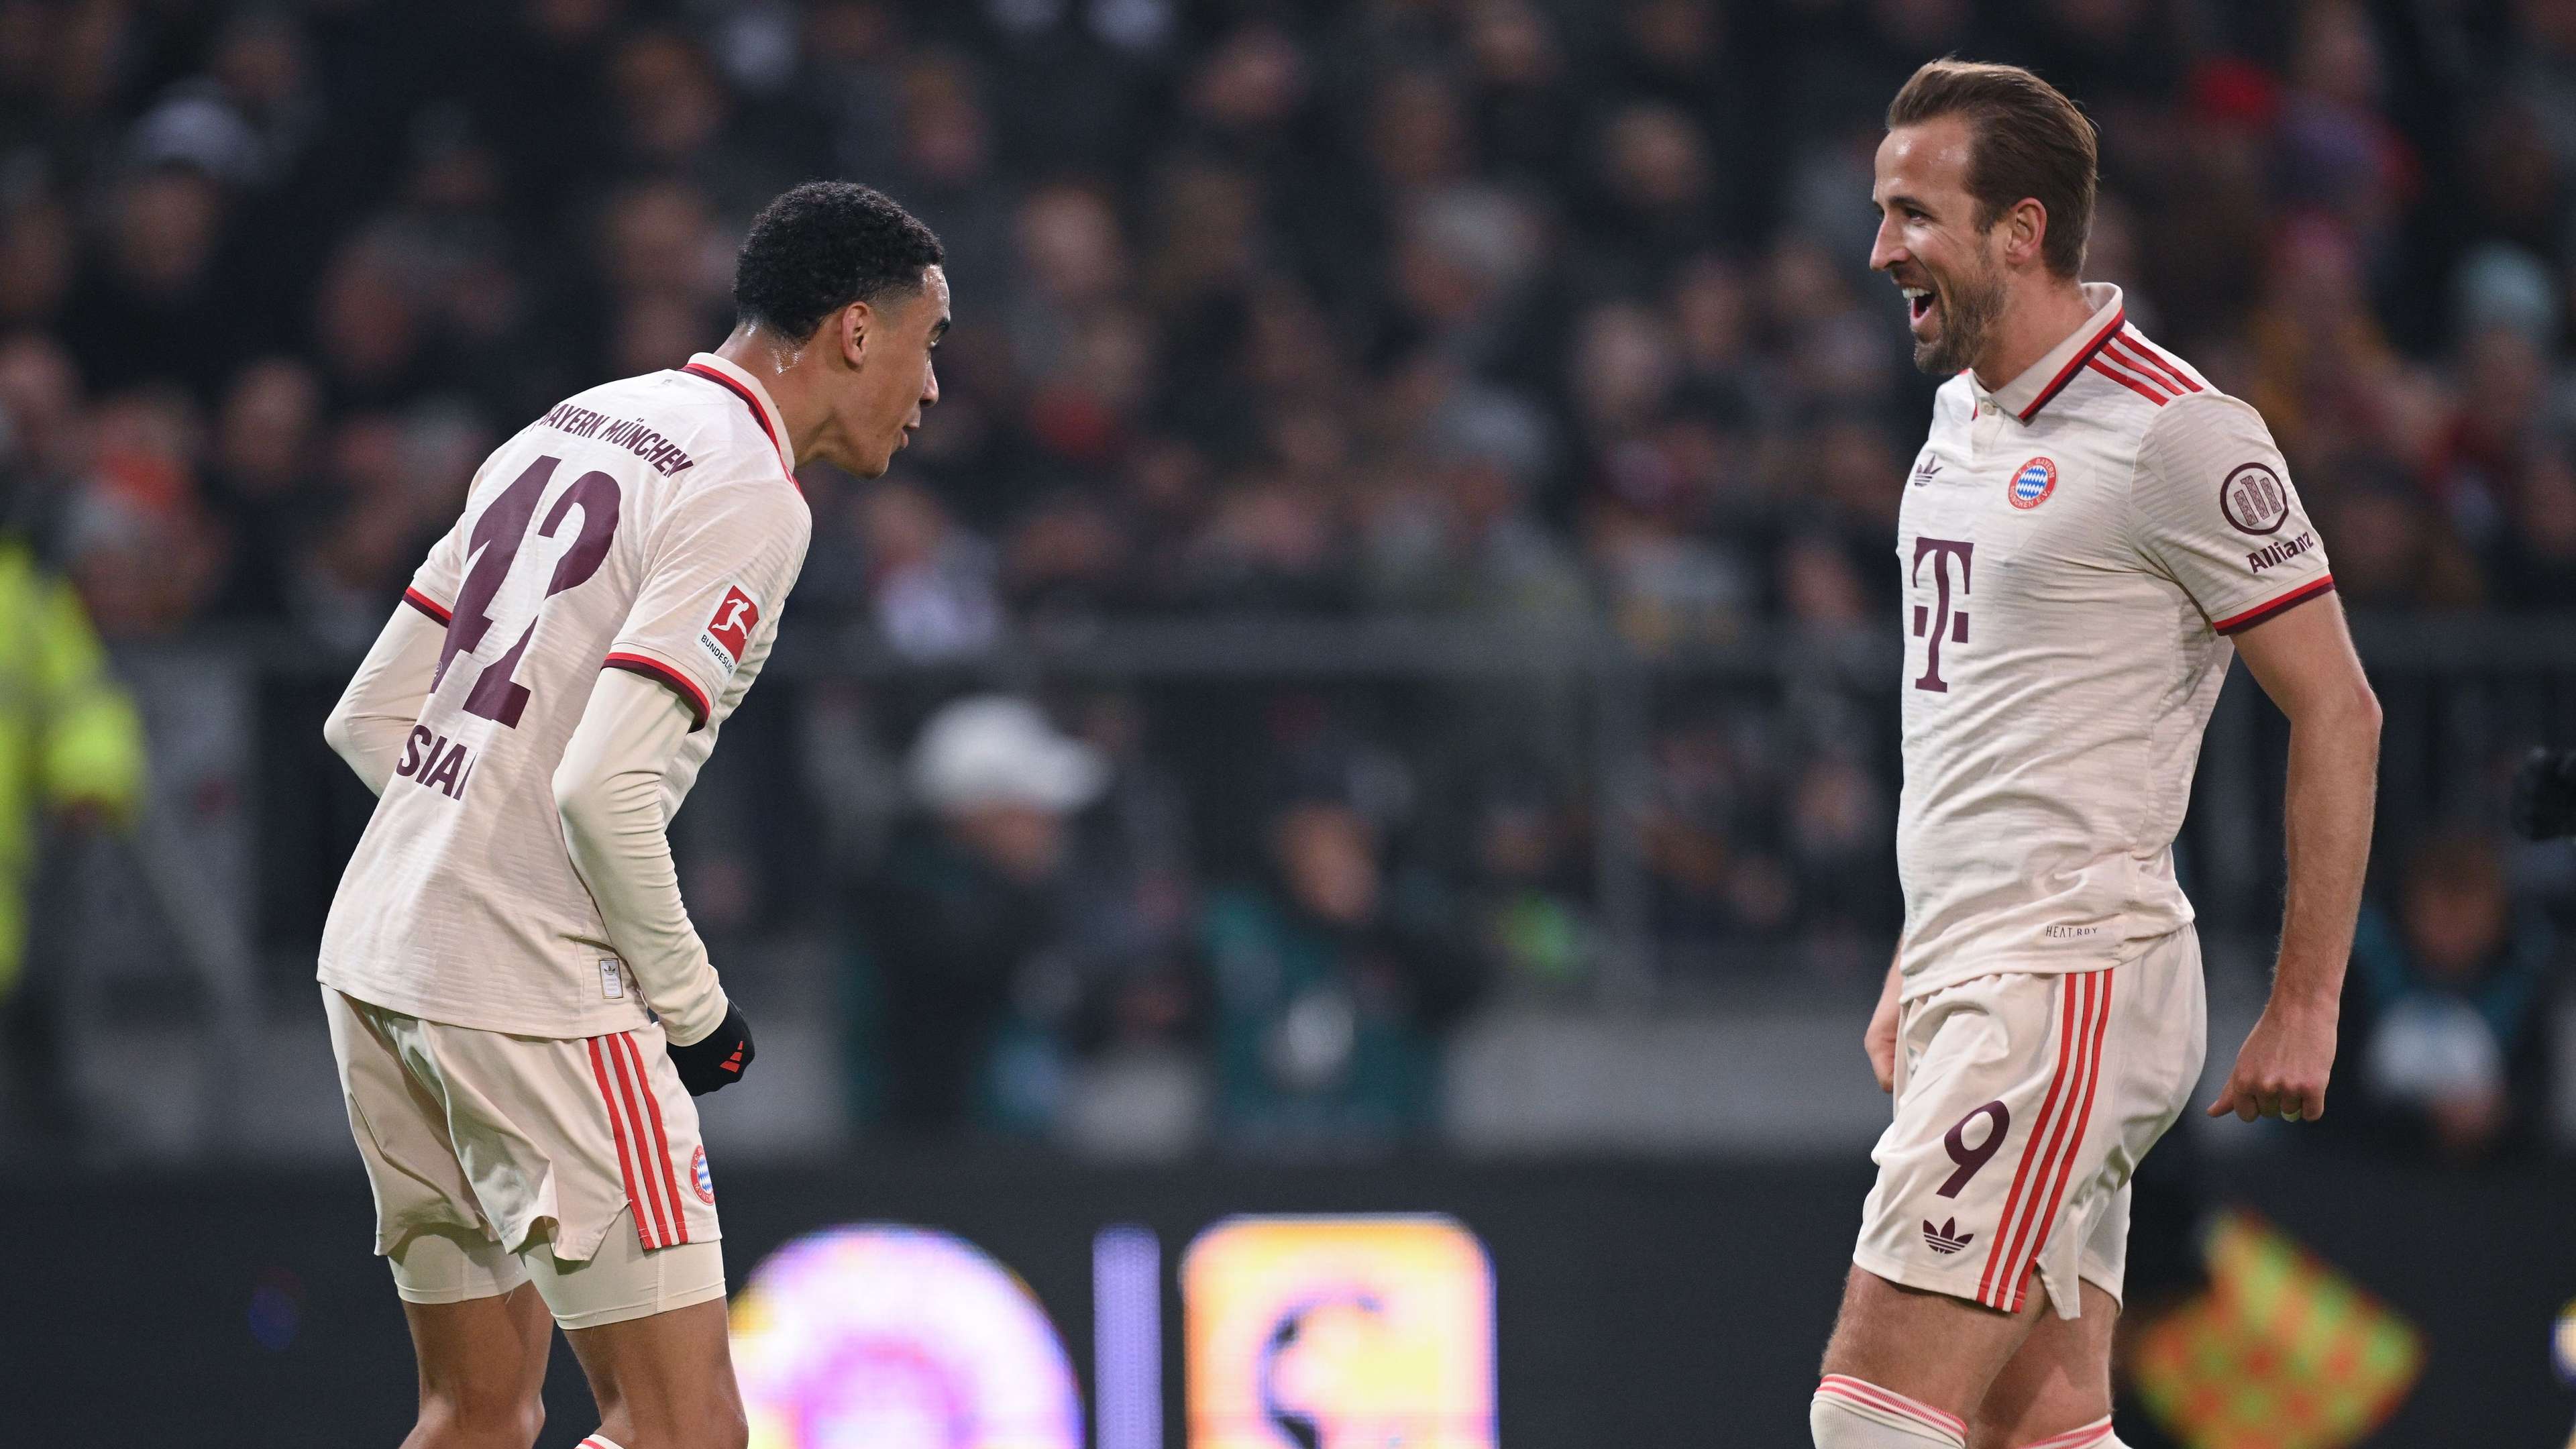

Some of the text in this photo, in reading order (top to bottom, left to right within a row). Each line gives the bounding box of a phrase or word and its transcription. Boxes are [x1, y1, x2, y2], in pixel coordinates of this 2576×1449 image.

[597, 417, 694, 478] MÜNCHEN
[429, 455, 622, 730] 42
[2246, 531, 2314, 574] Allianz
[1936, 1100, 2010, 1199] 9
